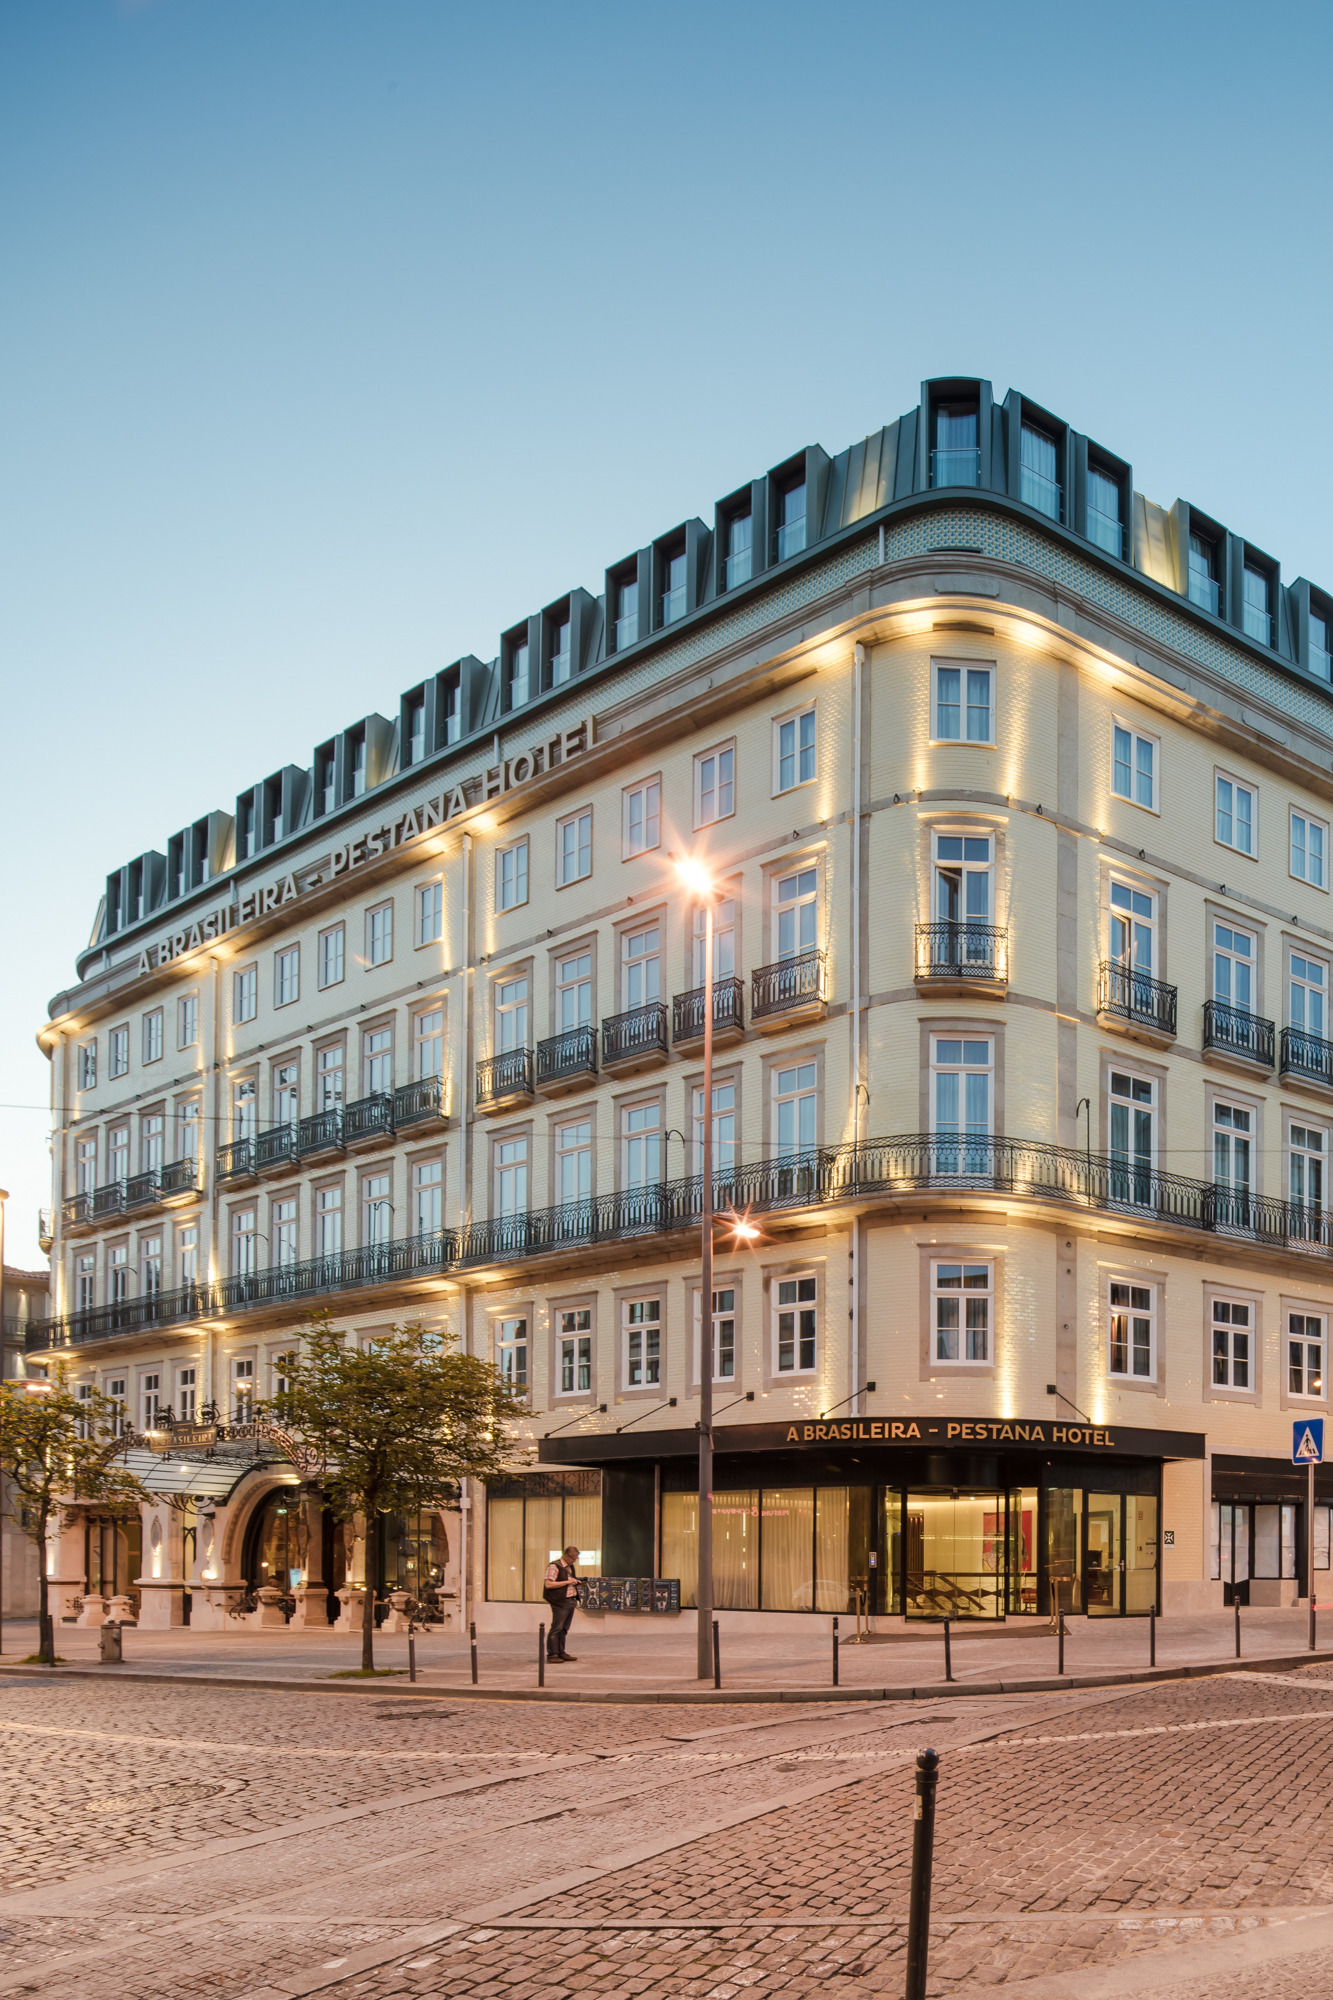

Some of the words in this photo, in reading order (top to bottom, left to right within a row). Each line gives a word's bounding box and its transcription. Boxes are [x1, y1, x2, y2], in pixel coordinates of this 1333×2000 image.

[137, 950, 152, 977] A
[157, 873, 298, 968] BRASILEIRA
[330, 784, 469, 879] PESTANA
[482, 714, 602, 801] HOTEL
[786, 1426, 799, 1442] A
[803, 1422, 921, 1441] BRASILEIRA
[947, 1422, 1045, 1442] PESTANA
[1052, 1427, 1115, 1446] HOTEL
